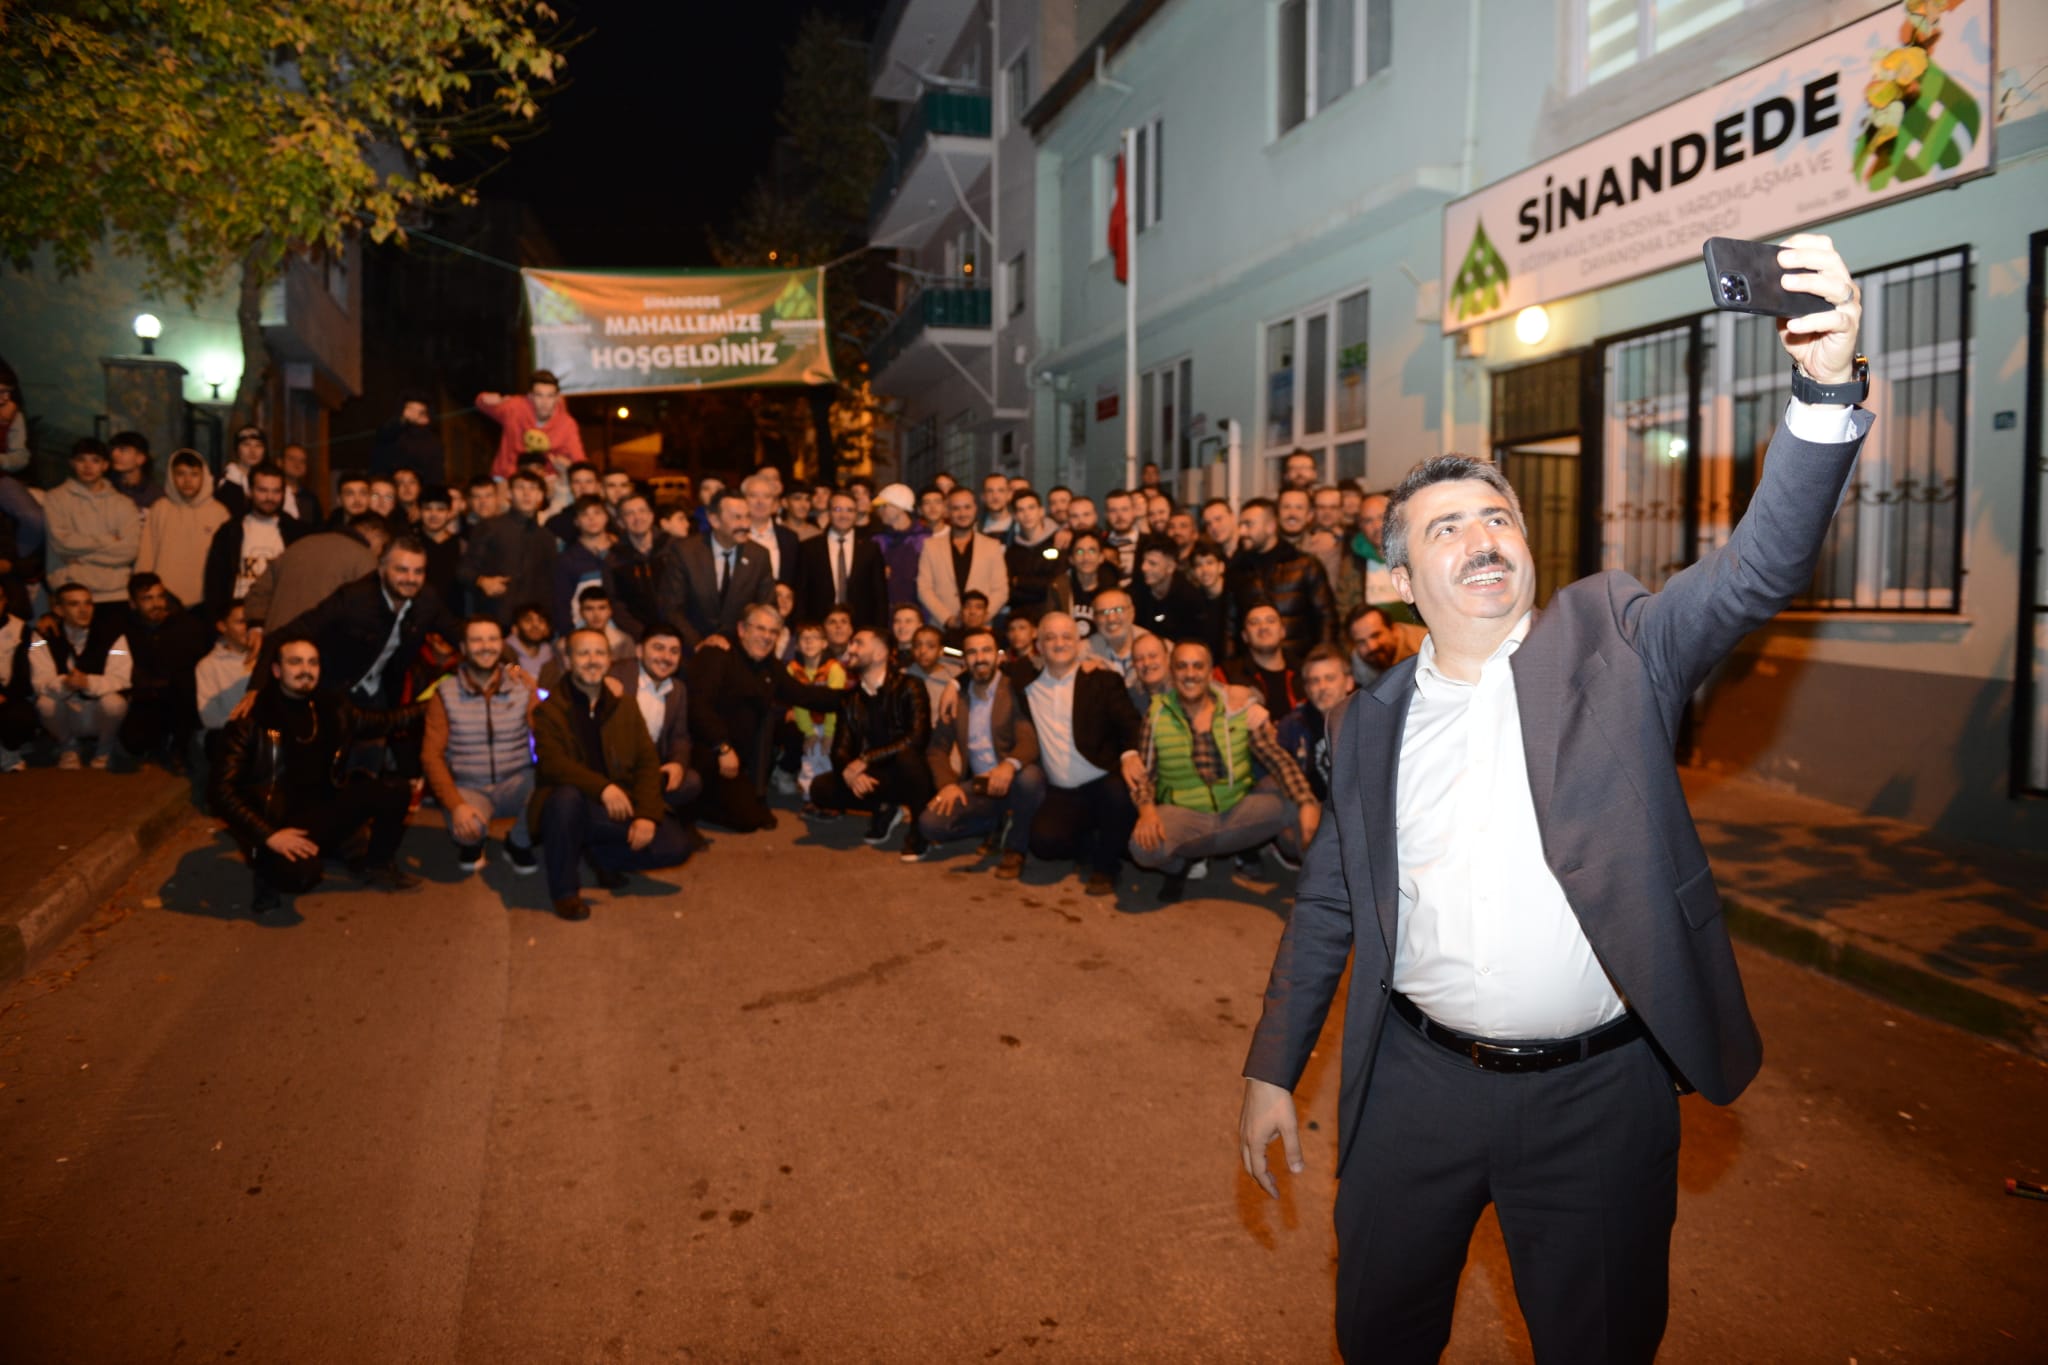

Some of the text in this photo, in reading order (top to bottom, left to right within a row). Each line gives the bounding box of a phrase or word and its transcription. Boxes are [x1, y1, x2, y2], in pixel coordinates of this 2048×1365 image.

[1517, 72, 1841, 243] SİNANDEDE
[1807, 150, 1833, 175] VE
[604, 309, 762, 336] MAHALLEMİZE
[591, 337, 778, 374] HOŞGELDİNİZ
